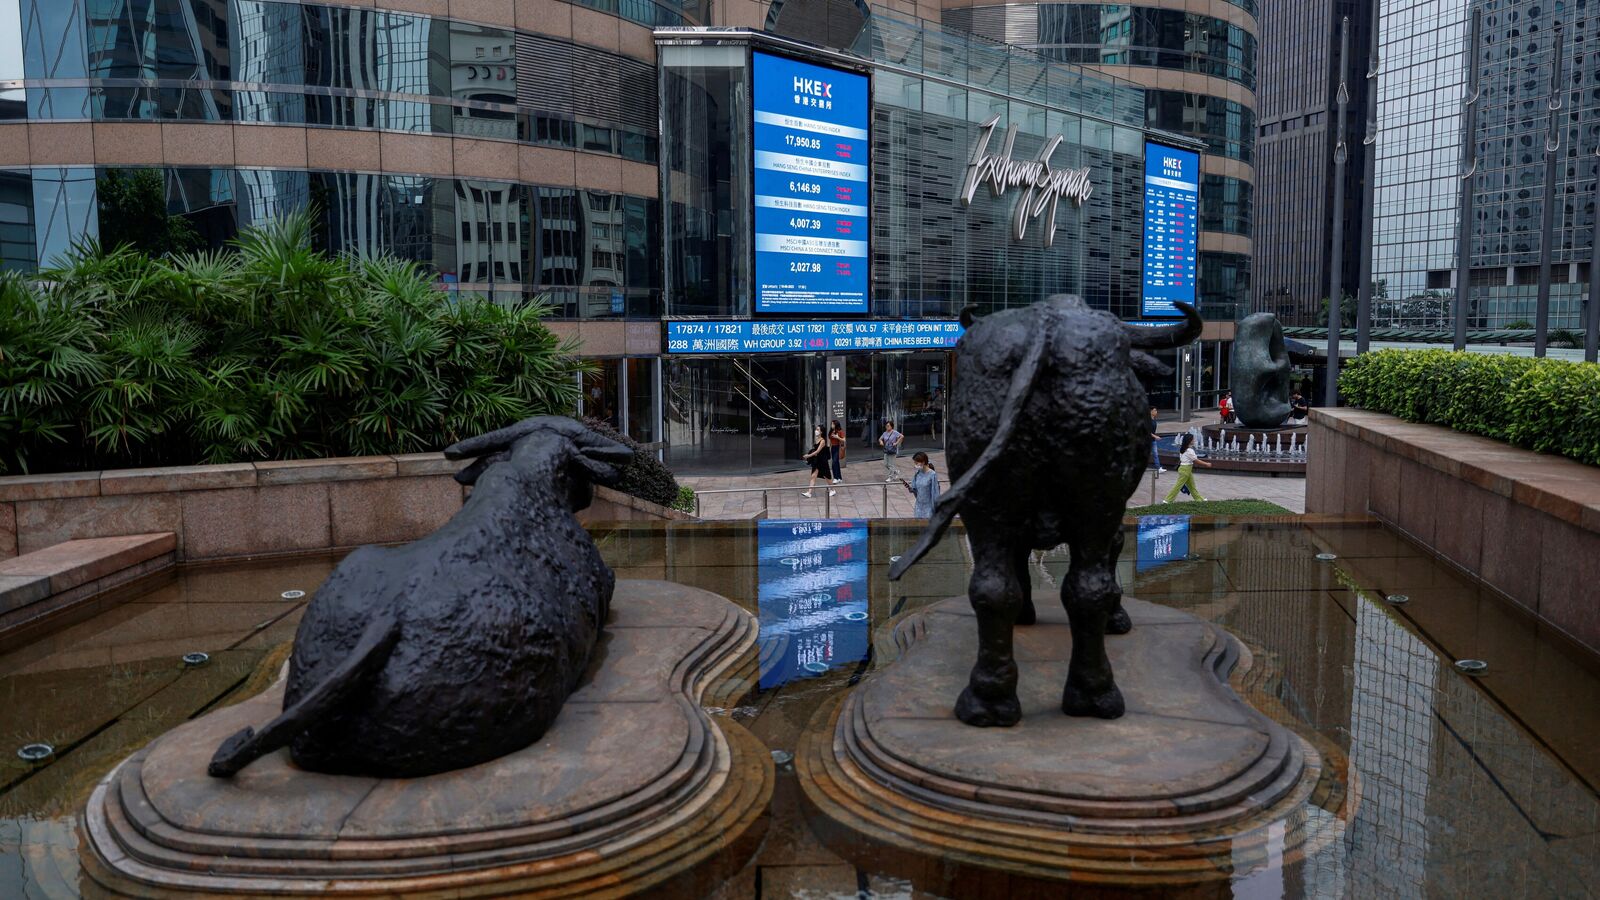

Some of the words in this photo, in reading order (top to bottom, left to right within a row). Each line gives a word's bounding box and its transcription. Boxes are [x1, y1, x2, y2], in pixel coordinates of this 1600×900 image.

[794, 76, 832, 98] HKEX
[785, 134, 820, 149] 17,950.85
[1163, 156, 1182, 170] HKEX
[961, 112, 1045, 240] Exchange
[1034, 132, 1093, 248] Square
[790, 181, 820, 194] 6,146.99
[790, 217, 821, 230] 4,007.39
[790, 262, 821, 273] 2,027.98
[676, 325, 704, 334] 17874
[707, 325, 711, 333] /
[715, 325, 742, 334] 17821
[752, 324, 784, 336] 最後成交
[788, 325, 805, 333] LAST
[807, 324, 825, 333] 17821
[856, 324, 867, 332] VOL
[870, 324, 877, 332] 57
[917, 324, 932, 332] OPEN
[933, 324, 942, 332] INT
[944, 324, 958, 332] 12073
[692, 339, 739, 351] 萬洲國際
[744, 340, 759, 349] WH
[760, 340, 785, 348] GROUP
[788, 339, 802, 348] 3.92
[834, 338, 852, 346] 00291
[885, 337, 903, 346] CHINA
[903, 336, 915, 345] RES
[916, 336, 932, 345] BEER
